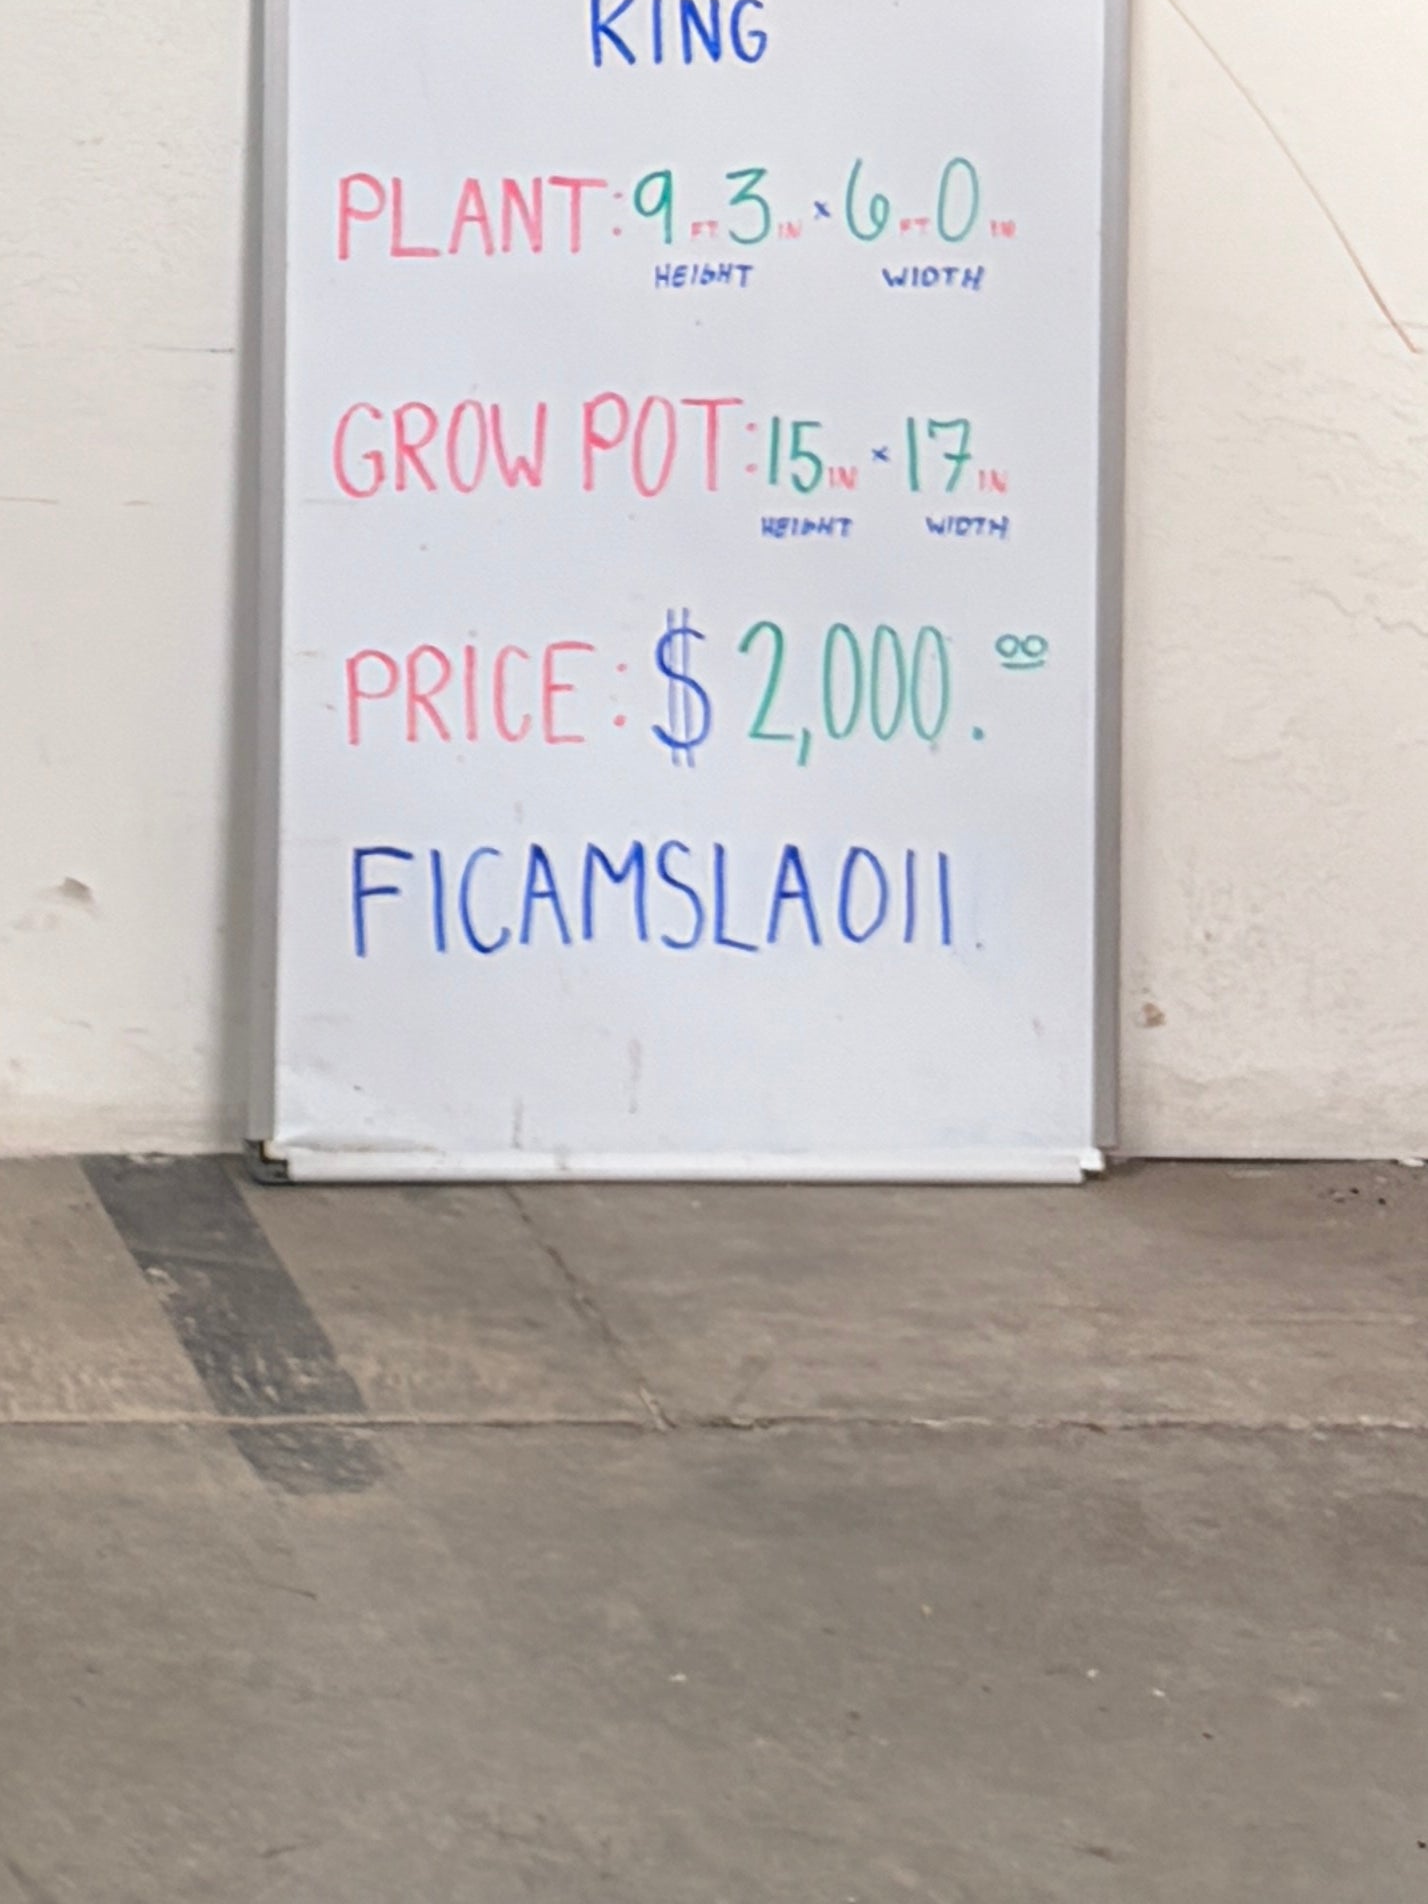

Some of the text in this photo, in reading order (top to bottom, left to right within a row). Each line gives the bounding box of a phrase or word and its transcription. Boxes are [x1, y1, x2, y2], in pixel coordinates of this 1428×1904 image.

[652, 262, 986, 292] HEIGHT WIDTH
[330, 398, 550, 500] GROW
[759, 515, 1010, 539] HEIGHT WIDTH
